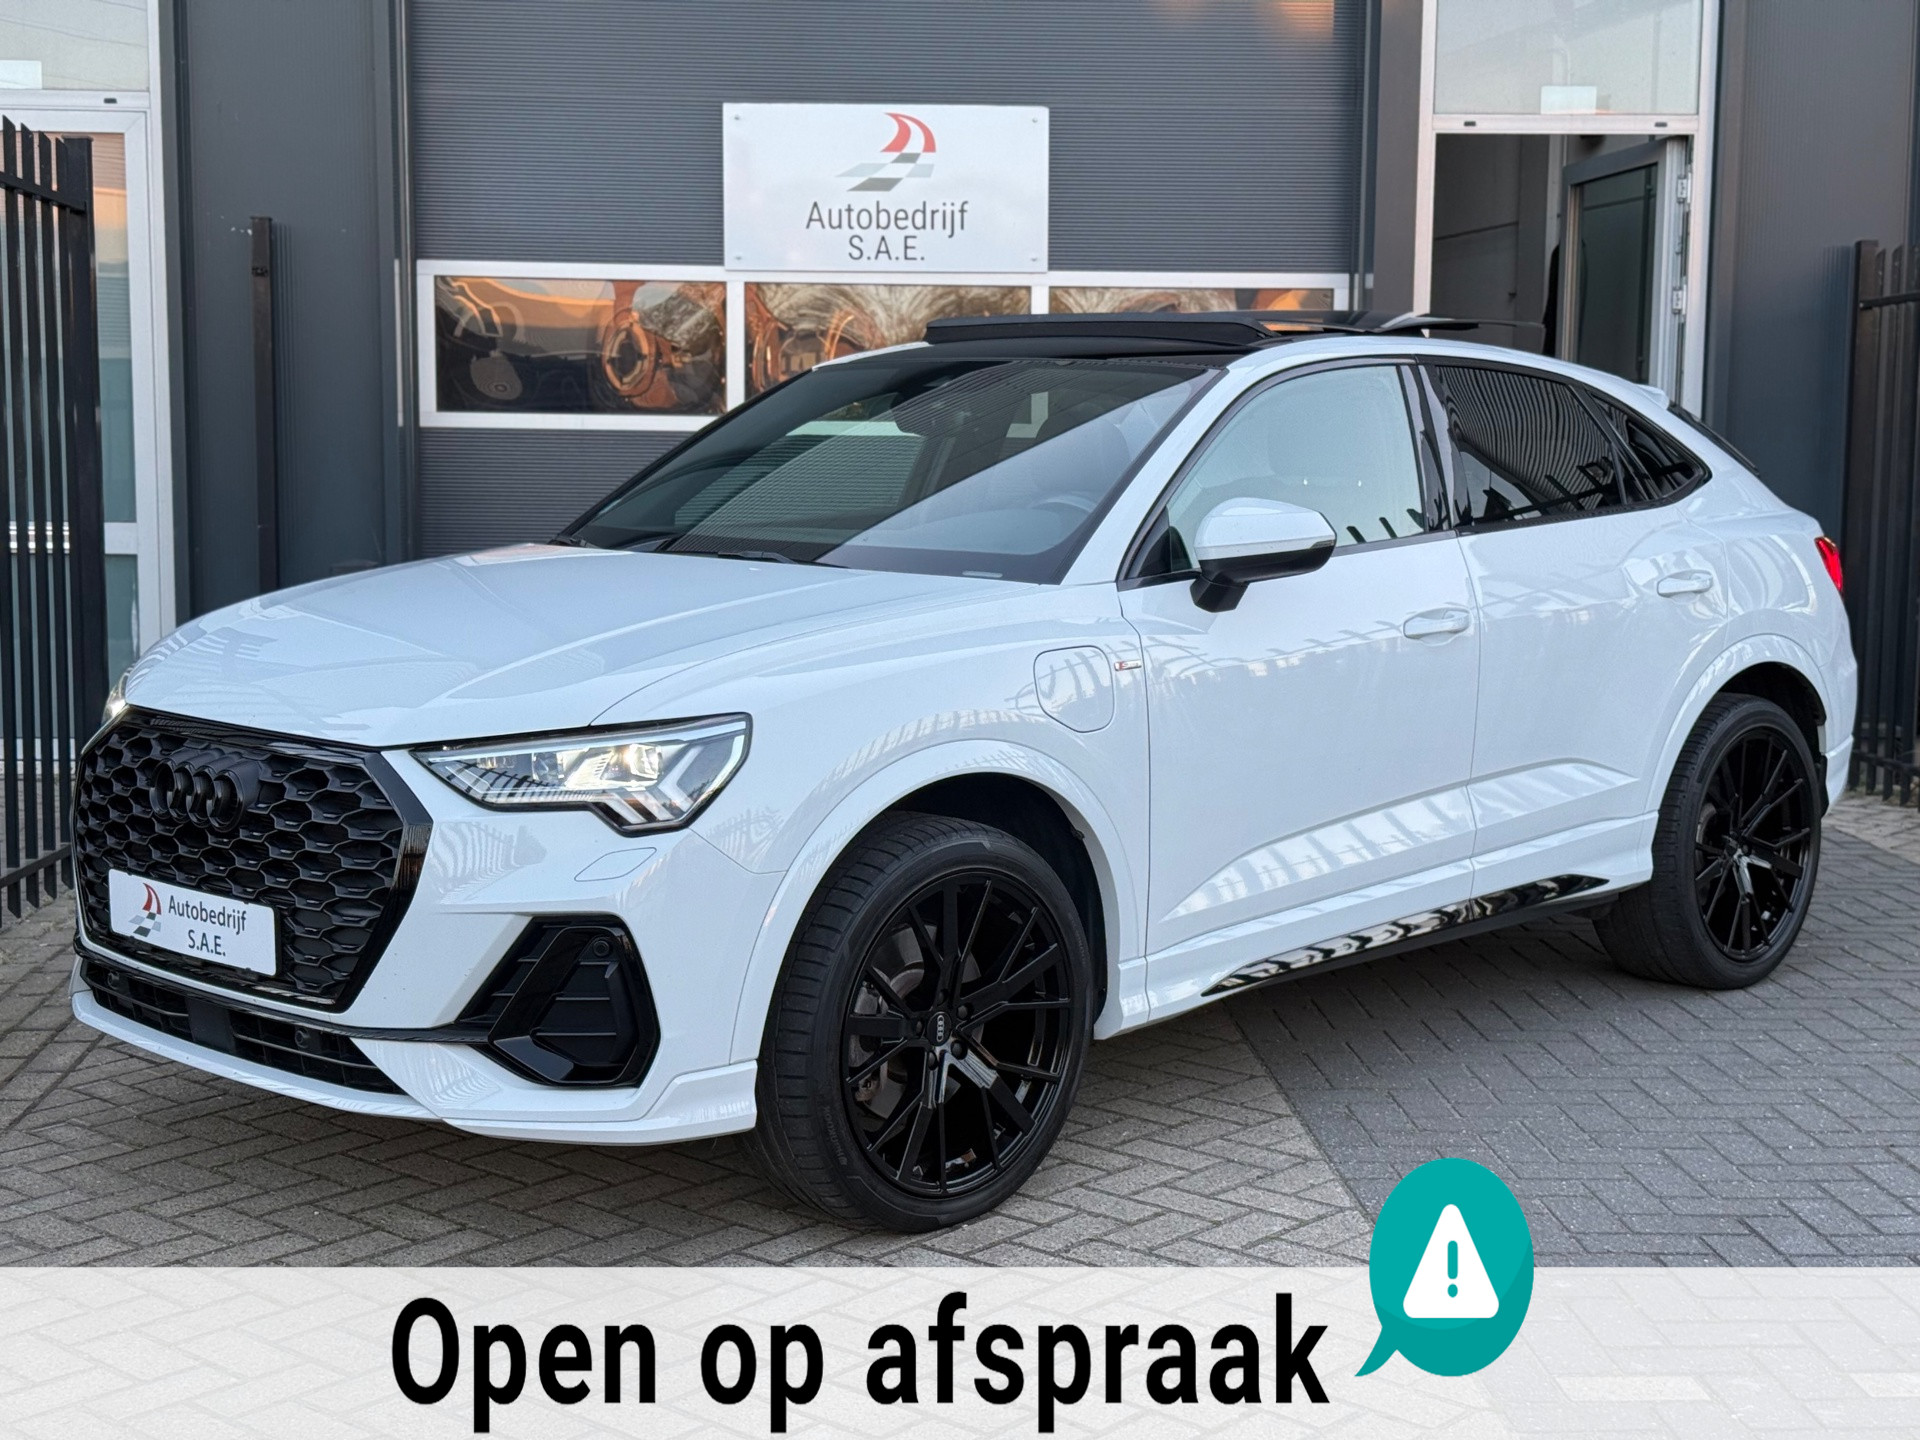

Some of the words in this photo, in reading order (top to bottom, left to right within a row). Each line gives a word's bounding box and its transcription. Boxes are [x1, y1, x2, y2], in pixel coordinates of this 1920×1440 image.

[806, 200, 968, 238] Autobedrijf
[848, 235, 925, 261] S.A.E.
[168, 895, 247, 935] Autobedrijf
[187, 929, 227, 957] S.A.E.
